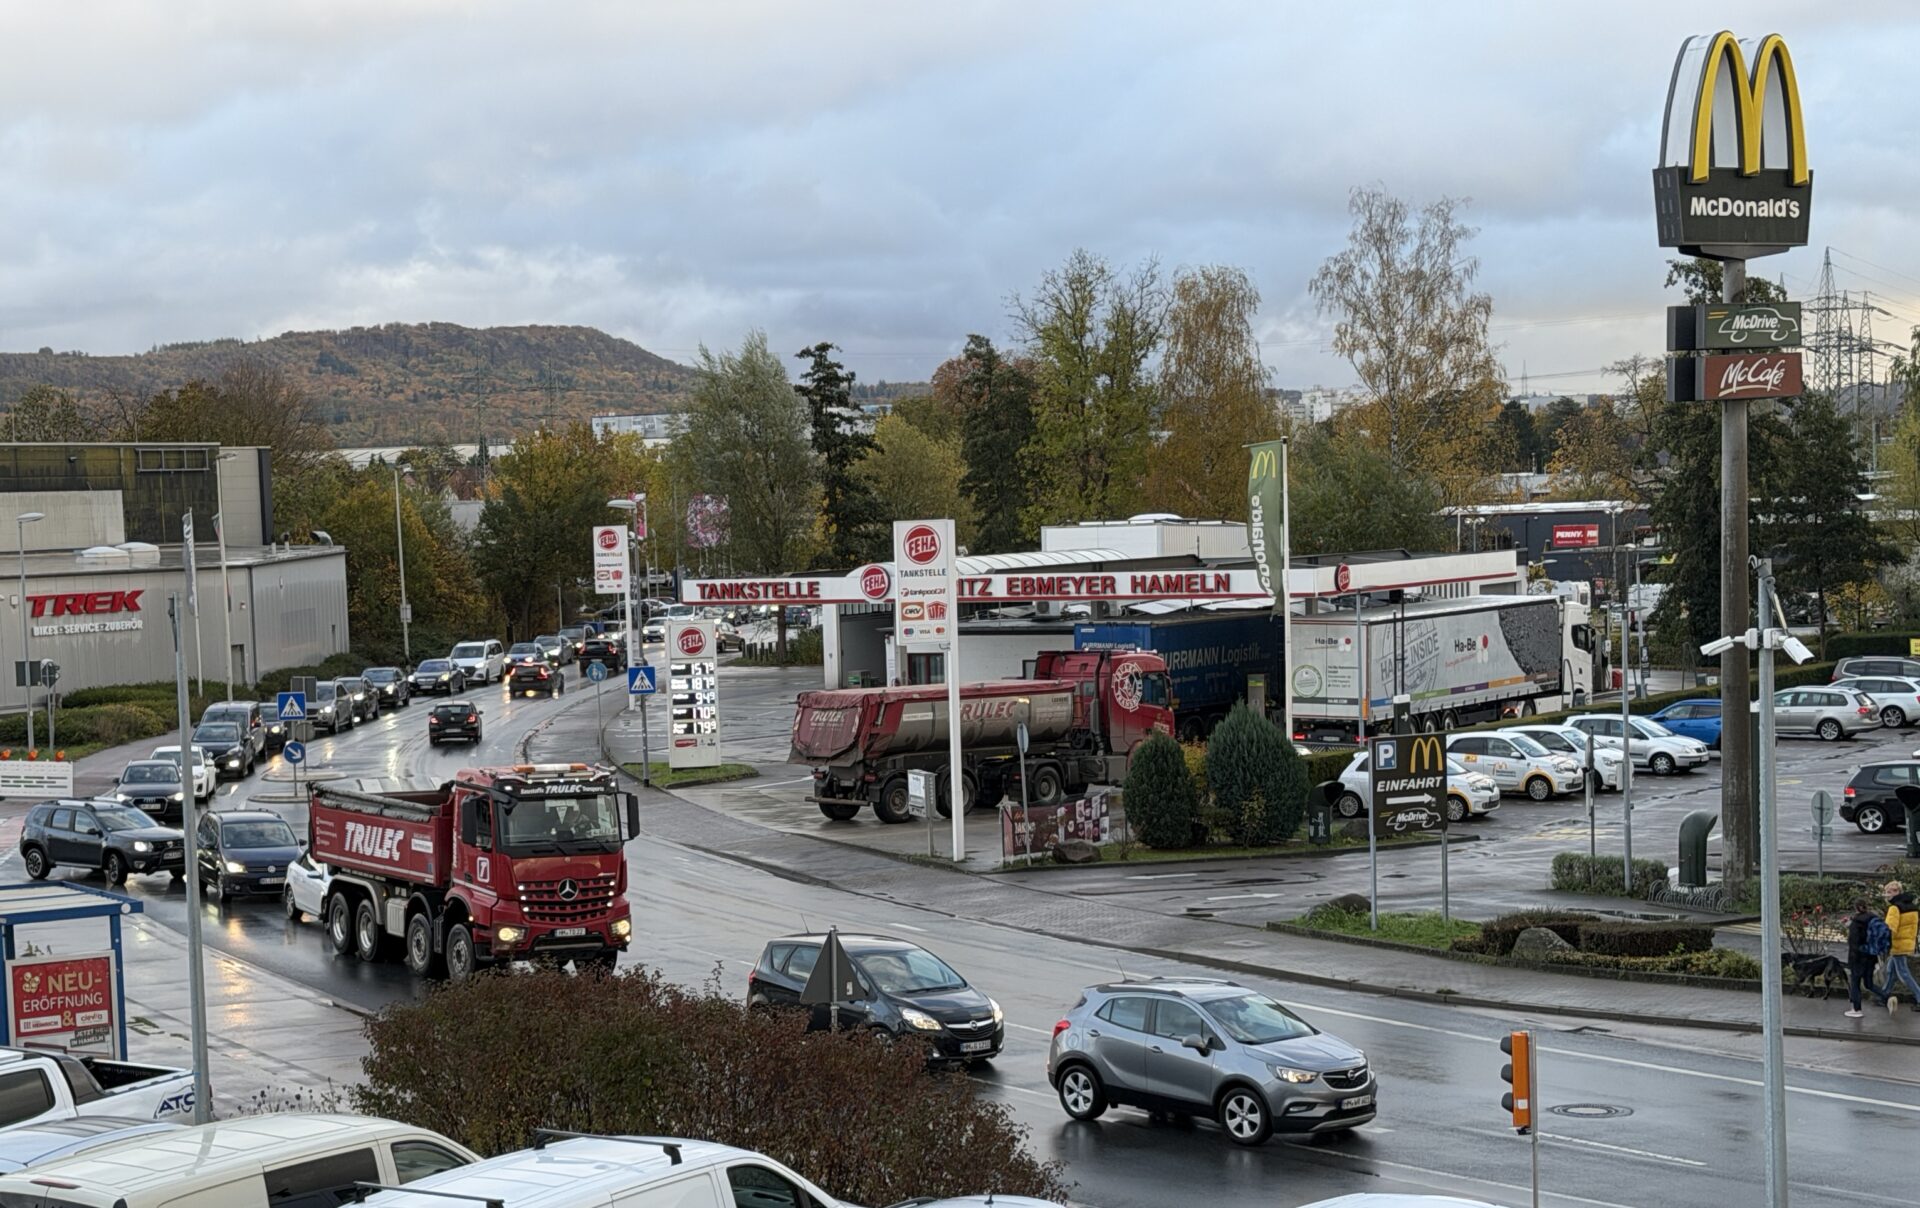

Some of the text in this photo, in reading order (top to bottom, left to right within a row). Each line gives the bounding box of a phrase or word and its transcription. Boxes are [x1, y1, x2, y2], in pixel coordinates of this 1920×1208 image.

[1690, 196, 1800, 218] McDonald's
[1731, 314, 1778, 330] McDrive
[1720, 358, 1785, 393] McCafé
[908, 535, 937, 557] FEHA
[900, 568, 947, 578] TANKSTELLE
[696, 573, 1230, 599] TANKSTELLE FEHA ITZ EBMEYER HAMELN
[26, 590, 144, 618] TREK
[65, 622, 99, 633] SERVICE
[104, 618, 143, 631] ZUBEHÖR
[681, 633, 703, 650] FEHA
[1411, 633, 1439, 664] INSIDE
[1221, 643, 1260, 666] Logistik
[959, 701, 1017, 720] RULEC
[545, 784, 581, 794] TRULEC
[1376, 776, 1443, 792] EINFAHRT
[1396, 812, 1429, 823] McDrive
[344, 821, 404, 861] TRULEC
[47, 971, 102, 994] NEU-
[23, 992, 102, 1013] ERÖFFNUNG
